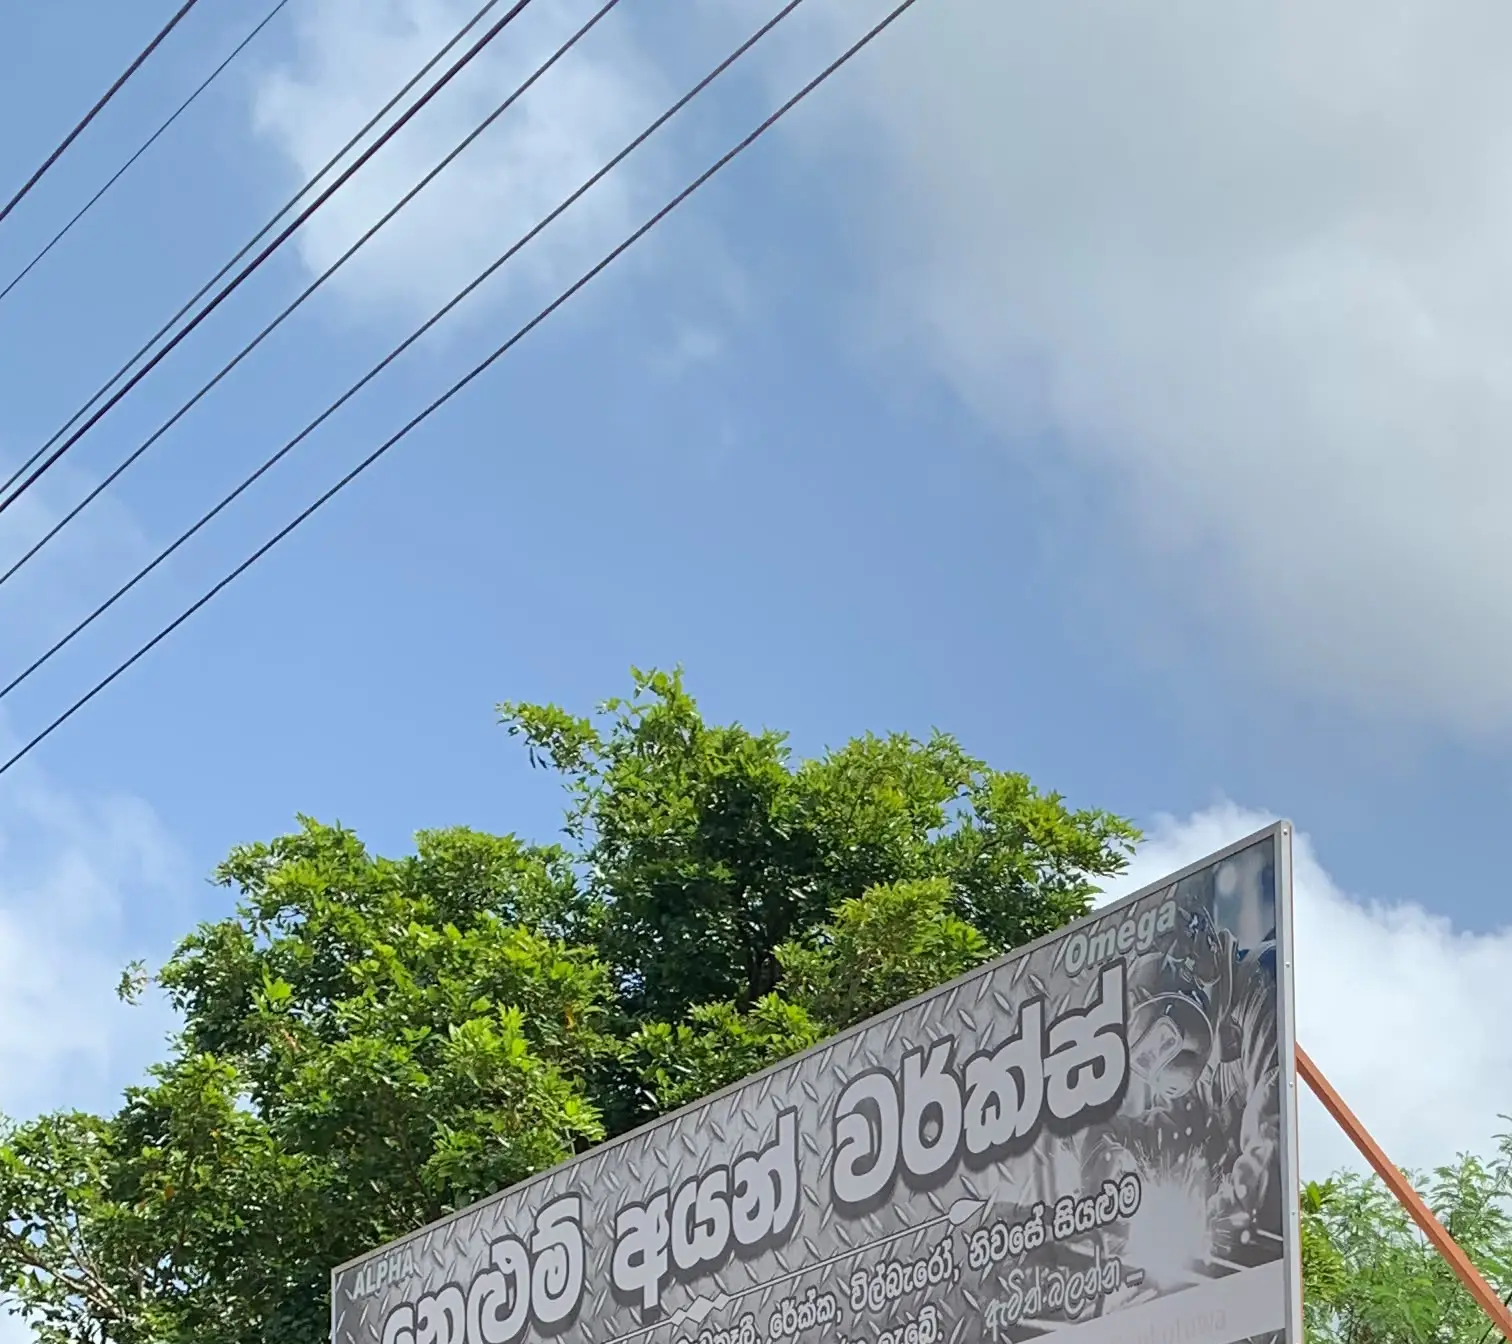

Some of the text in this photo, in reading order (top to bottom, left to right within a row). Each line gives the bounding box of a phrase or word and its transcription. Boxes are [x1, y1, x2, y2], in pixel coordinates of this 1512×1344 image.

[1064, 900, 1176, 975] Omega
[611, 1106, 798, 1309] අයන්
[833, 960, 1128, 1204] වර්ක්ස්
[969, 1204, 1044, 1270] නිවසේ
[351, 1250, 415, 1298] ALPHA
